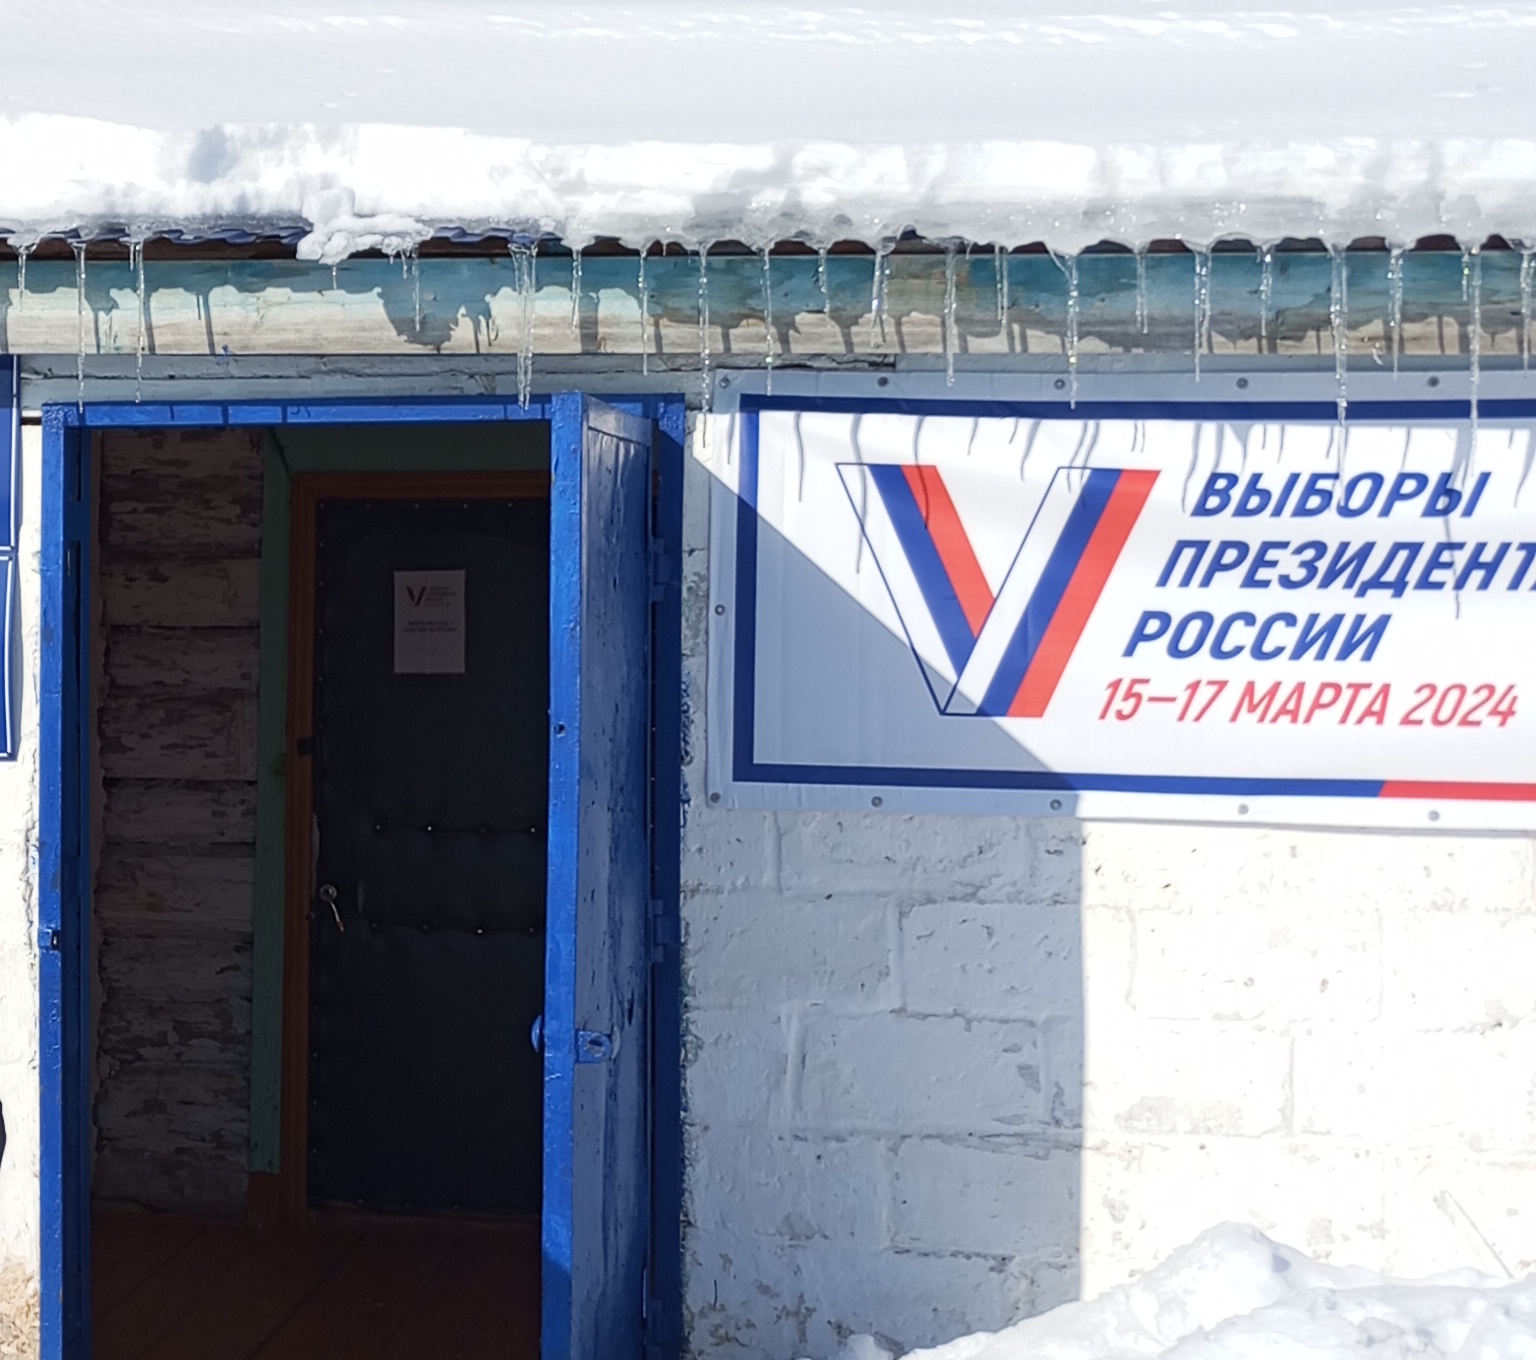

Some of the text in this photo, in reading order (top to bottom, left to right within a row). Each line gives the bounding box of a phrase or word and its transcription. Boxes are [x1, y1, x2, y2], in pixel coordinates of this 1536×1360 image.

[1189, 470, 1493, 520] ВЫБОРЫ
[1156, 539, 1536, 600] ПРЕЗИДЕНТ
[1122, 609, 1393, 662] РОССИИ
[1229, 680, 1394, 726] МАРТА
[1398, 682, 1520, 728] 2024
